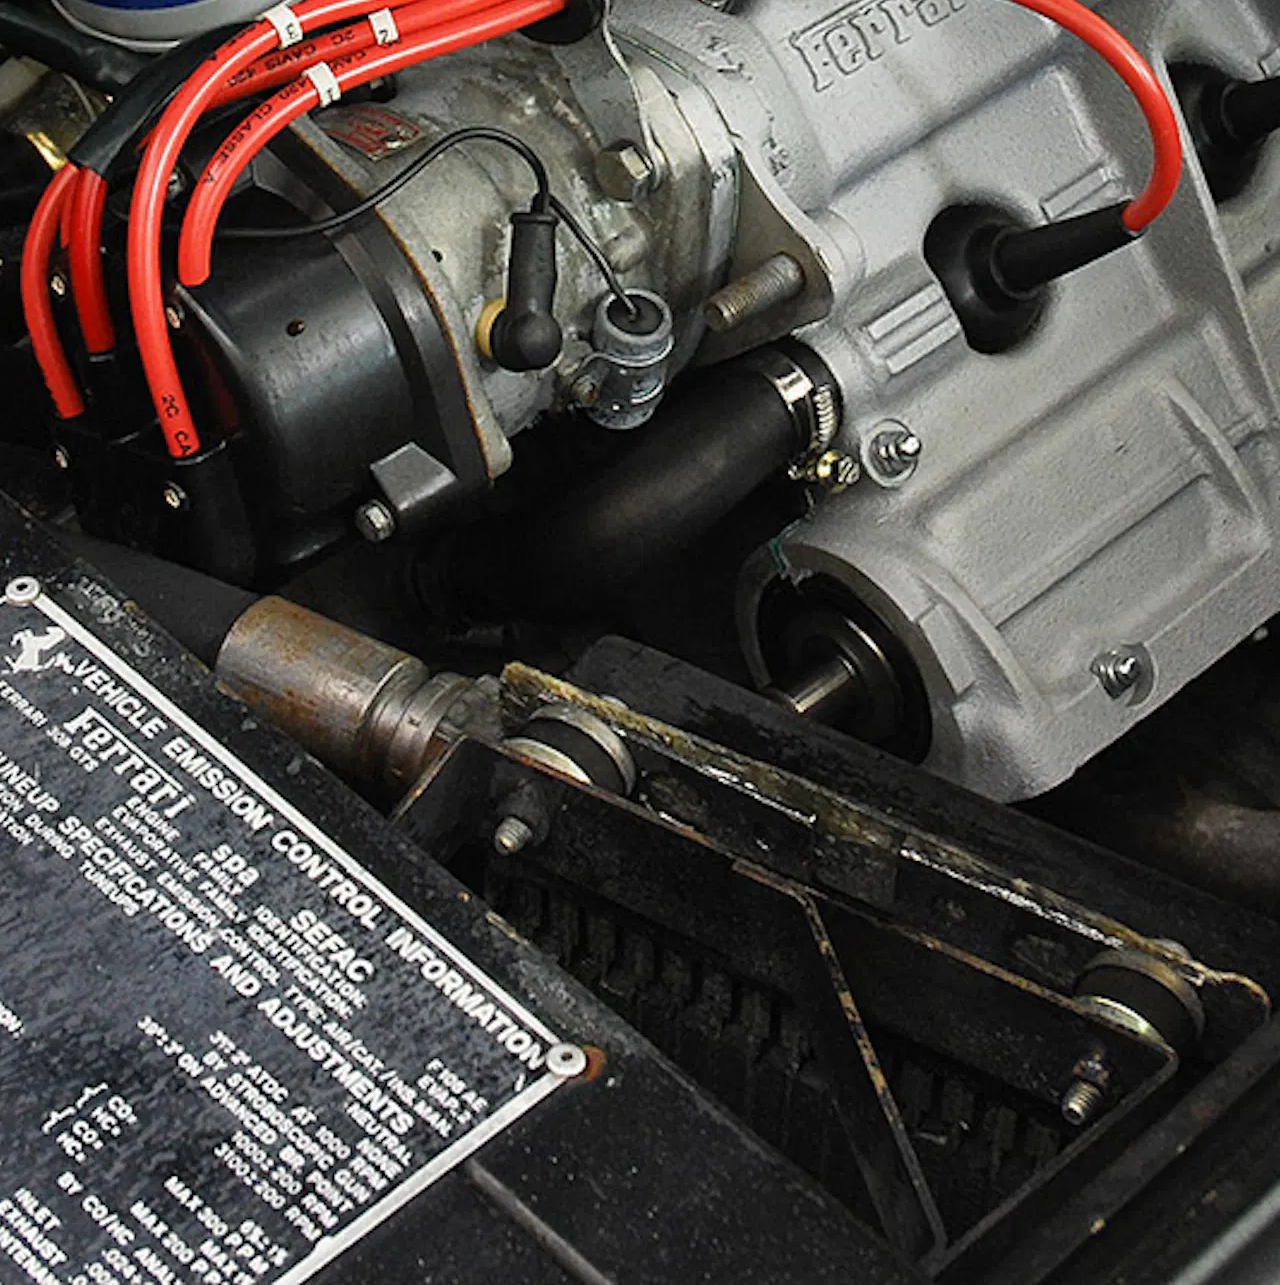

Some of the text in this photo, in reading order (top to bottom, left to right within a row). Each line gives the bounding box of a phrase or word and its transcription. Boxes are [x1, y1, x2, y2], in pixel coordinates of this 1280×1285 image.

[68, 745, 100, 773] GTS
[24, 812, 76, 859] DURING
[78, 859, 140, 917] TUNEUPS
[62, 706, 196, 818] Ferrari
[289, 909, 374, 982] SEFAC
[68, 658, 551, 1069] VEHICLE EMISSION CONTROL INFORMATION
[94, 815, 158, 871] EXHAUST
[156, 870, 222, 932] EMISSION
[215, 927, 281, 987] CONTROL
[111, 805, 353, 1020] EVAPORATIVE FAMILY IDENTIFICATION:
[125, 795, 368, 1009] ENGINE FAMILY IDENTIFICATION:
[58, 815, 213, 953] SPECIFICATIONS
[208, 954, 262, 997] AND
[257, 997, 414, 1134] ADJUSTMENTS
[177, 1052, 205, 1078] ON
[199, 1075, 278, 1145] ADVANCED
[305, 1169, 354, 1213] POINT
[201, 1050, 371, 1204] BY STROBOSCOPIC GUN
[245, 1064, 388, 1191] ATDC AT 1000 RPM
[345, 1102, 412, 1166] NEUTRAL
[355, 1137, 402, 1179] NONE
[14, 1187, 61, 1231] INLET
[56, 1170, 83, 1195] BY
[81, 1194, 135, 1246] CO/HC
[129, 1200, 195, 1264] MAX 200
[163, 1175, 229, 1237] MAX 300
[283, 1205, 322, 1242] RPM
[300, 1192, 339, 1229] RPM
[199, 1238, 239, 1278] MAX
